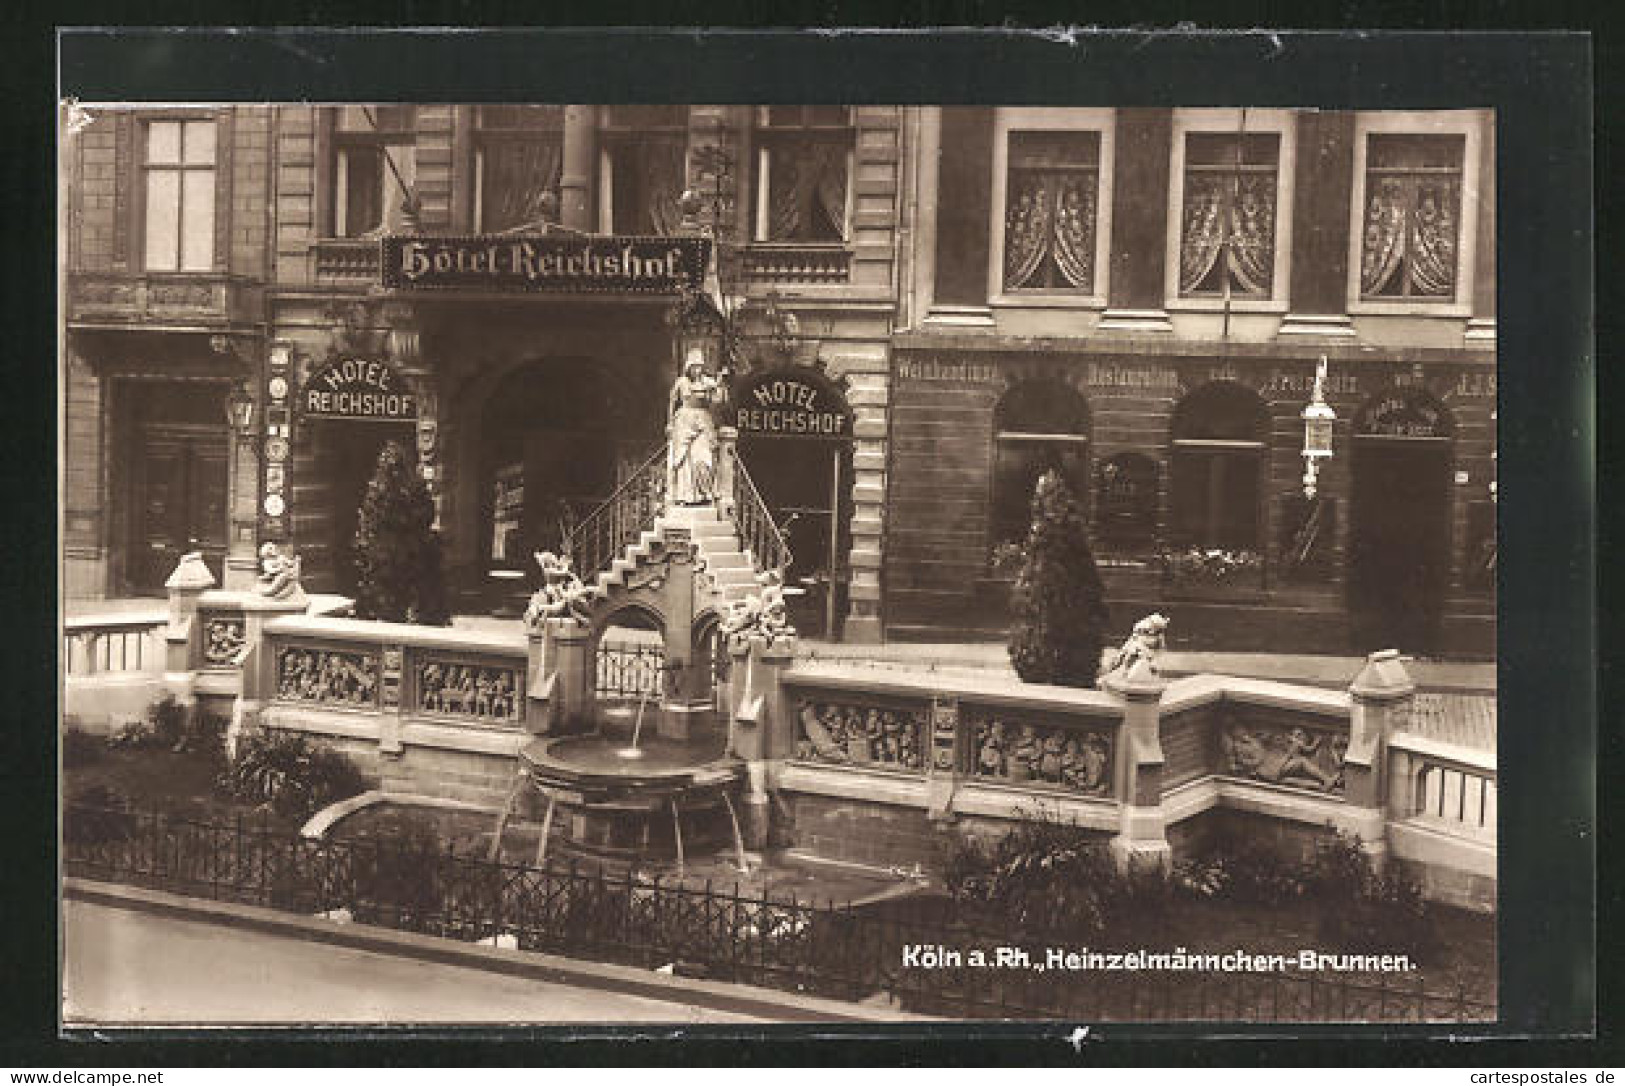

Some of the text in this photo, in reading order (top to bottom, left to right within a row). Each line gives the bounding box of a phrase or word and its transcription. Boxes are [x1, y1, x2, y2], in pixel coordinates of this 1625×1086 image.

[324, 359, 391, 391] HOTEL
[308, 389, 414, 416] REICHSHOF
[752, 381, 818, 412] HOTEL
[737, 407, 846, 433] REICHSHOF
